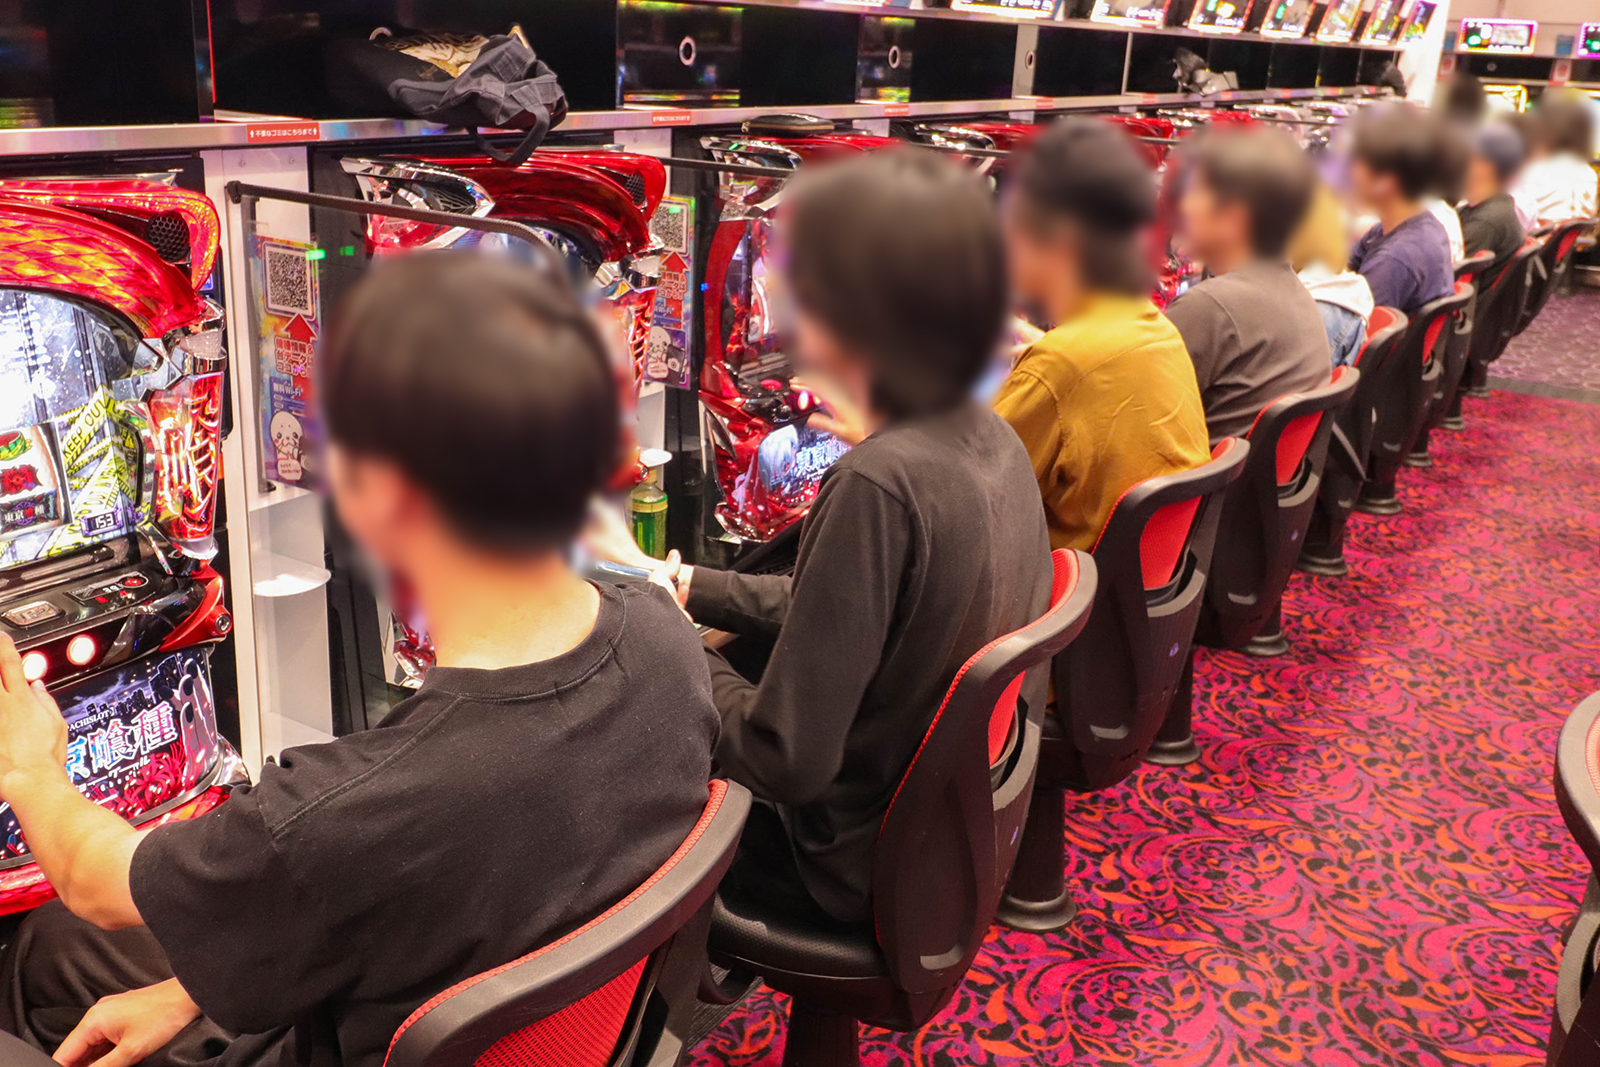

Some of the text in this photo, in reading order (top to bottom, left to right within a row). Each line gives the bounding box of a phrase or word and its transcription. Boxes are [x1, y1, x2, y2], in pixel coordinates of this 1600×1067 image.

[62, 426, 83, 459] KEEP
[95, 513, 114, 529] 153
[68, 707, 114, 732] ACHISLOT】
